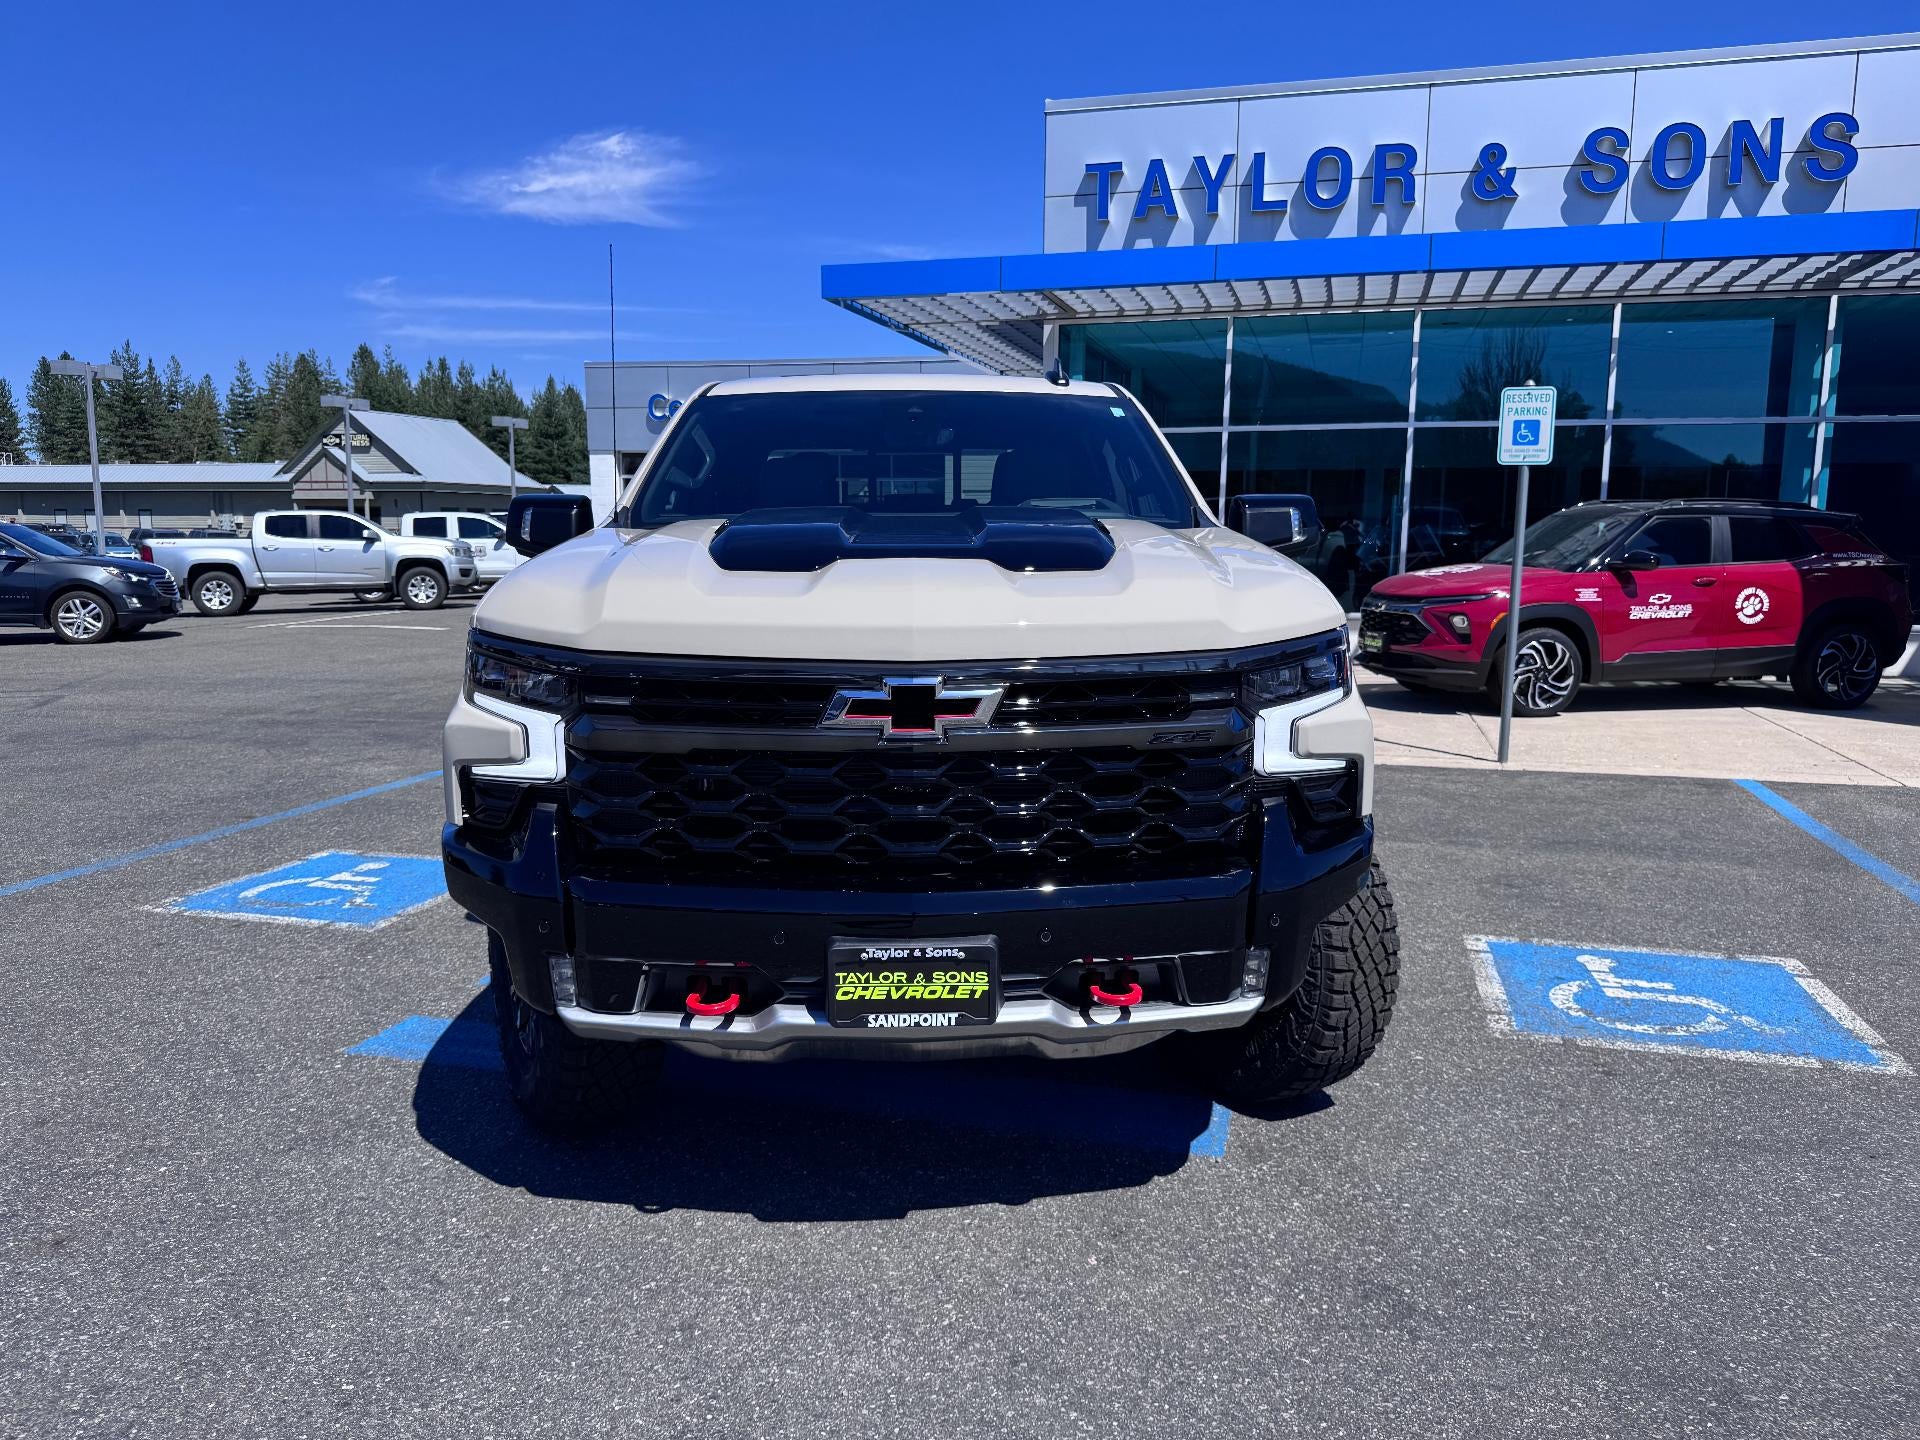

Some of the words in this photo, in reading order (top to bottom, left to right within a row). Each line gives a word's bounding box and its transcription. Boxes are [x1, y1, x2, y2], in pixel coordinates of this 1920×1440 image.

[1084, 143, 1418, 221] TAYLOR
[1472, 142, 1517, 200] &
[1579, 111, 1860, 194] SONS
[1505, 393, 1551, 404] RESERVED
[1507, 406, 1548, 416] PARKING
[341, 434, 369, 442] NTURAL
[1669, 603, 1693, 611] SONS
[1629, 610, 1693, 620] CHEVROLET
[866, 948, 910, 961] Taylor
[913, 949, 922, 958] &
[925, 947, 959, 958] Sons
[835, 972, 907, 985] TAYLOR
[914, 972, 926, 986] &
[932, 971, 989, 984] SONS
[835, 985, 990, 1001] CHEVROLET
[867, 1012, 959, 1028] SANDPOINT
